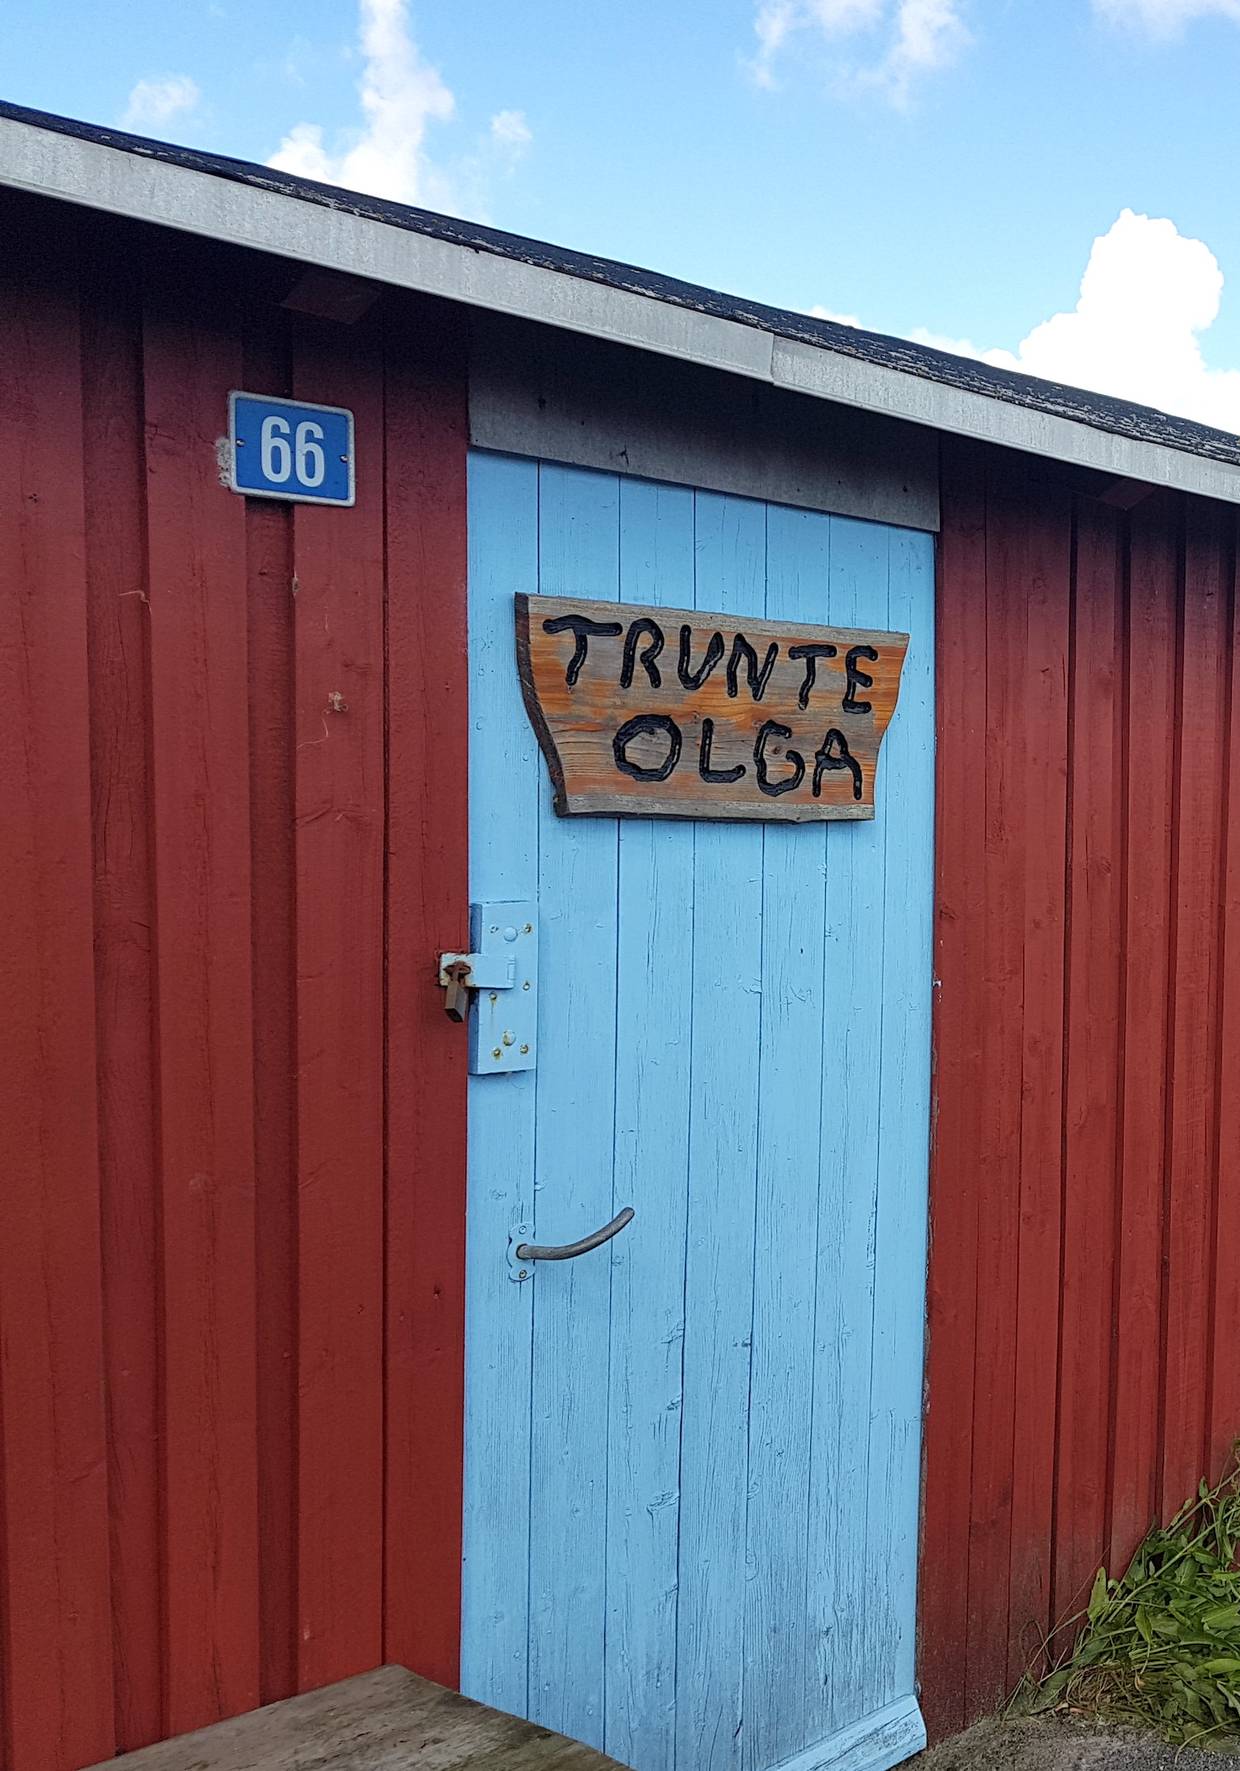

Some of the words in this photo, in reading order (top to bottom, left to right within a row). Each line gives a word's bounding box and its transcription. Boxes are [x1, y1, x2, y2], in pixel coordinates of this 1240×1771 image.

[260, 415, 325, 487] 66
[543, 614, 878, 713] TRUNTE
[613, 714, 862, 801] OLGA
